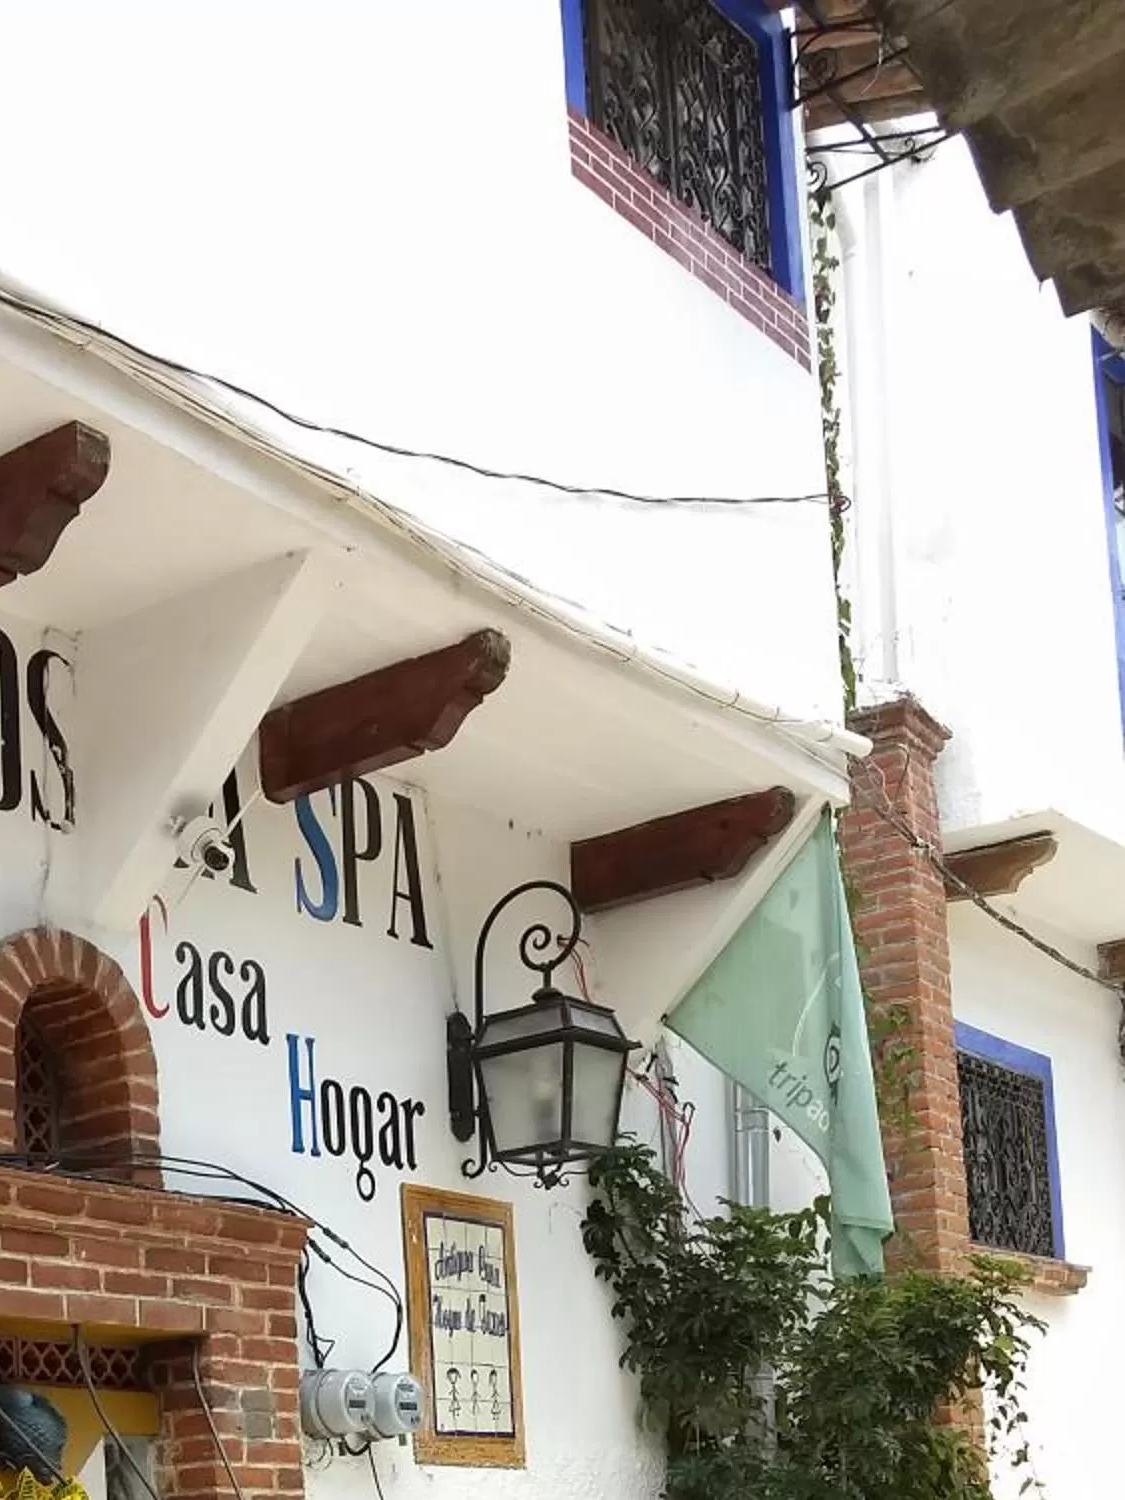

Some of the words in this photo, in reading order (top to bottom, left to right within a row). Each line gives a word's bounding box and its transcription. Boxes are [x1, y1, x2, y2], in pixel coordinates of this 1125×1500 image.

[294, 775, 434, 949] SPA
[139, 894, 270, 1046] Casa
[286, 1033, 424, 1202] Hogar
